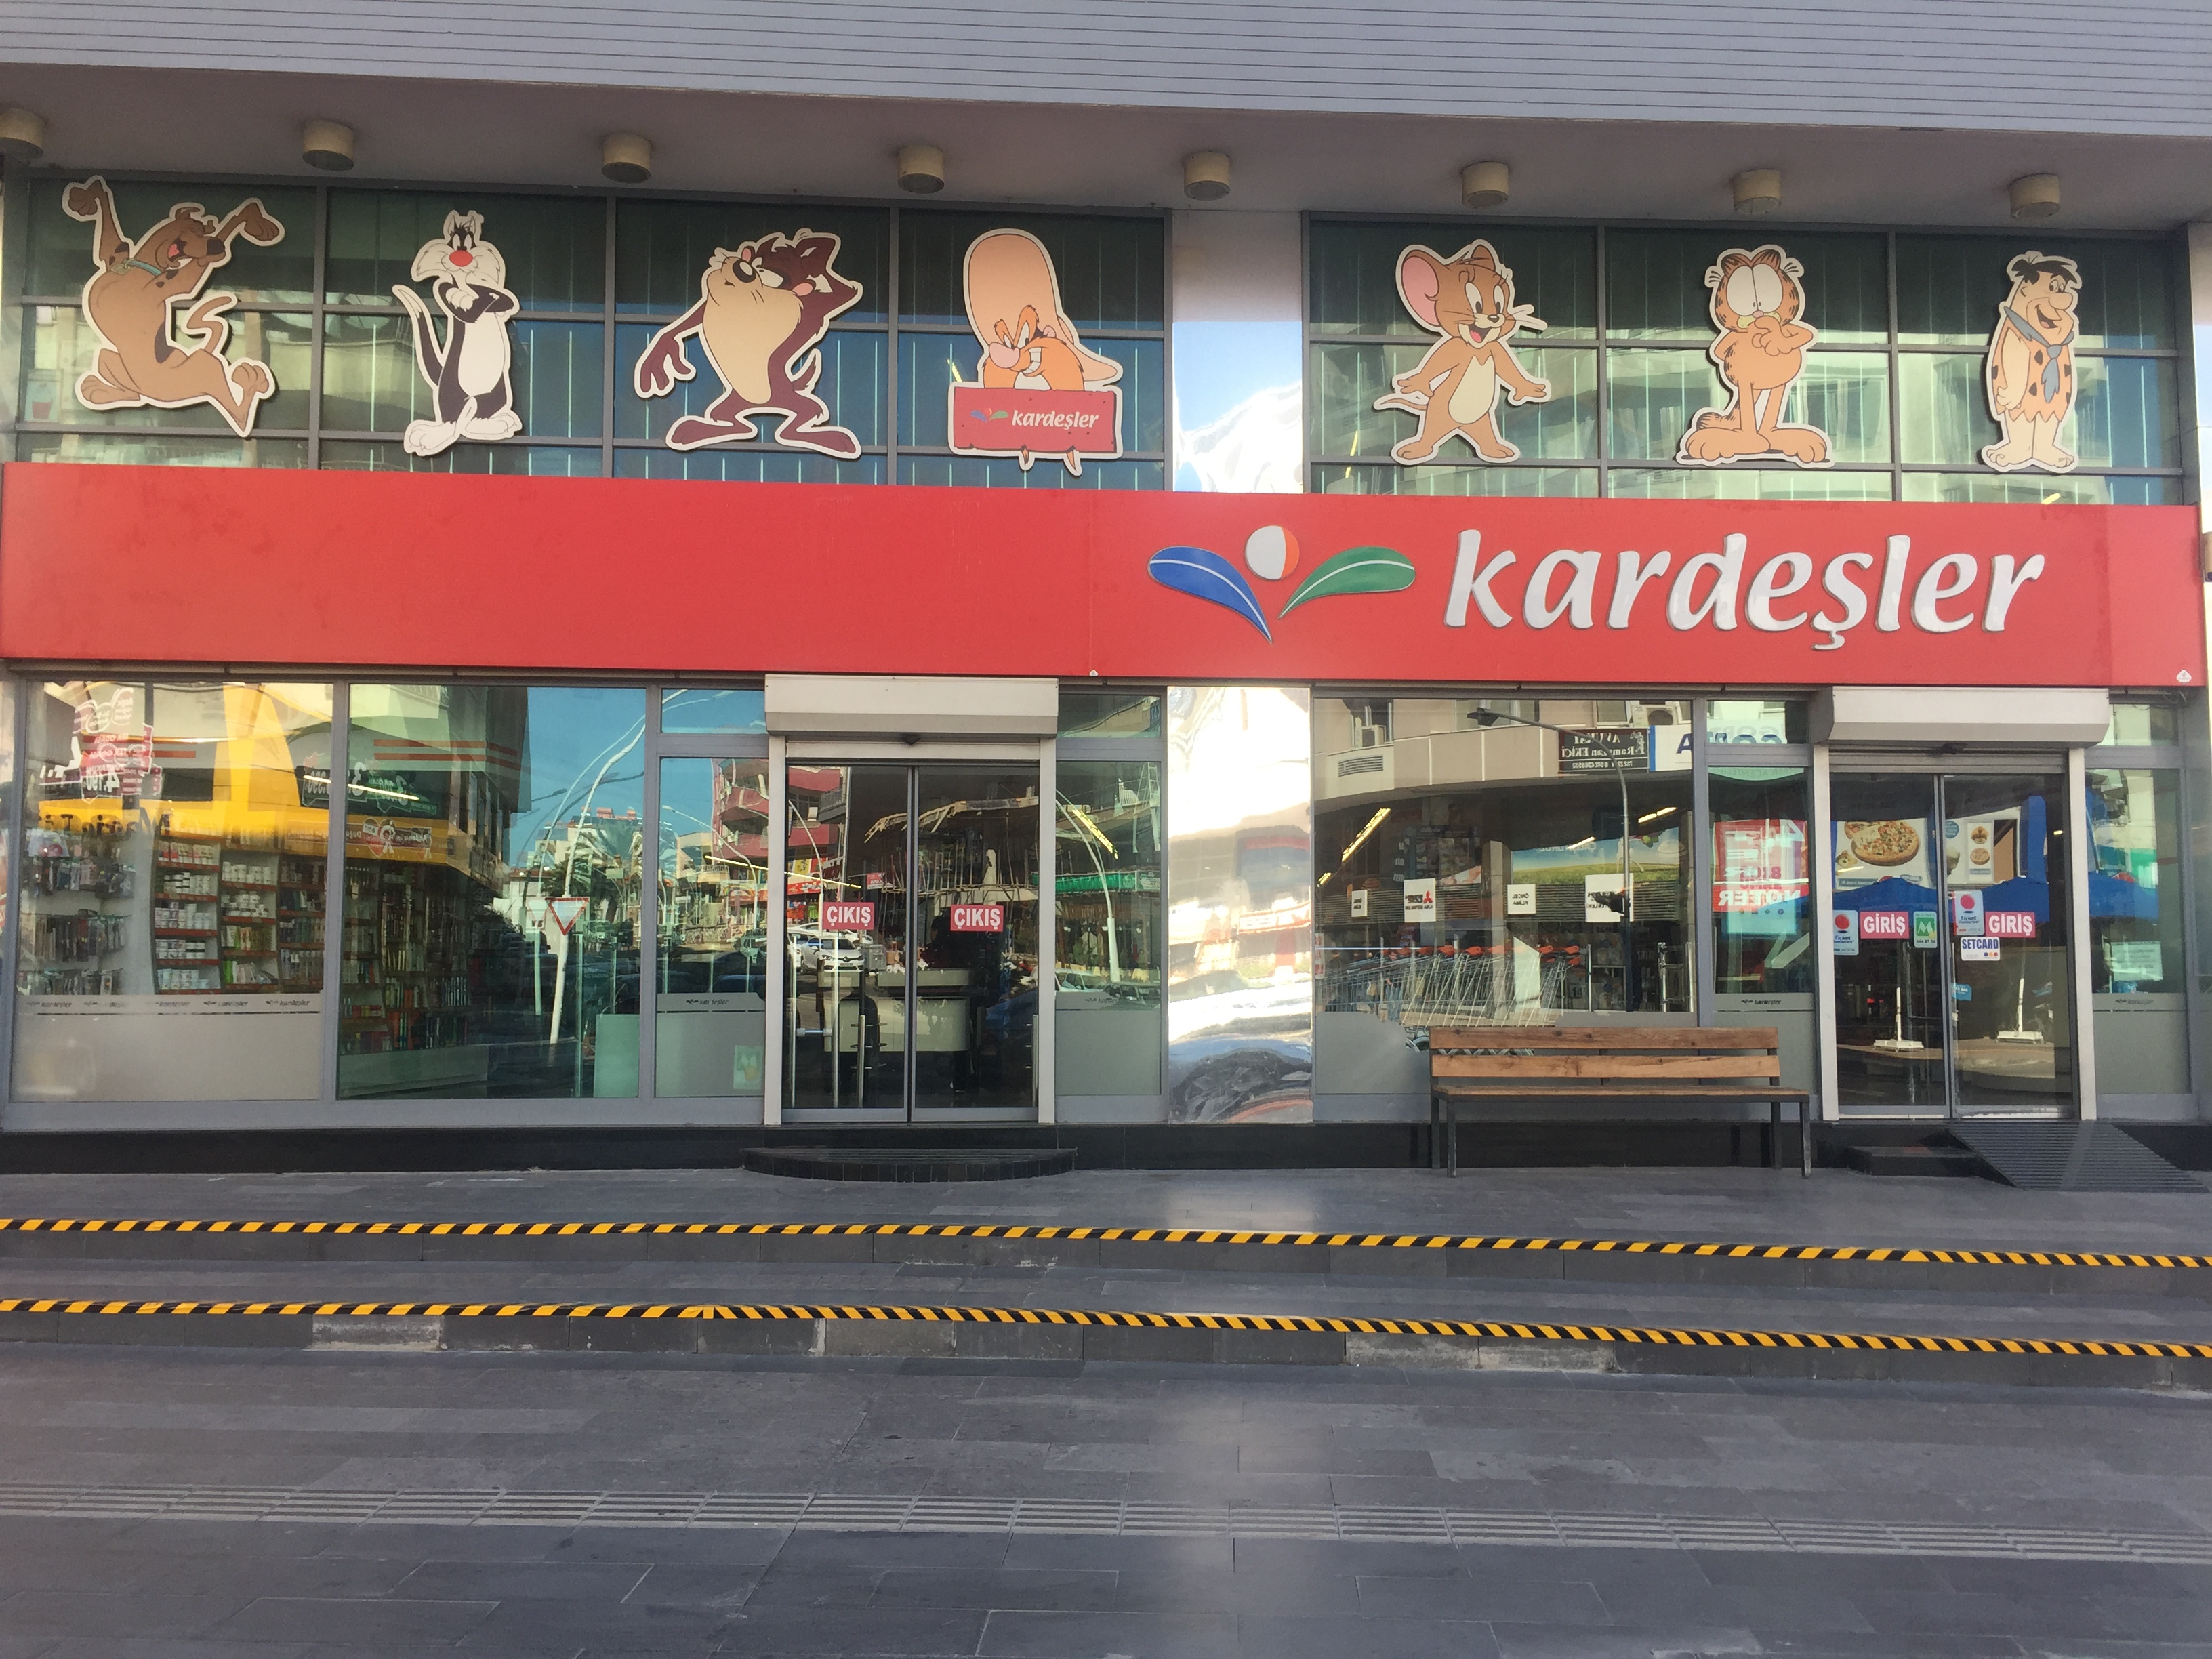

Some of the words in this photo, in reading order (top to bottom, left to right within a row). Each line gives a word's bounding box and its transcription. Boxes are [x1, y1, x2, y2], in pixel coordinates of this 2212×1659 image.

[1012, 409, 1099, 430] kardeşler
[1443, 529, 2045, 652] kardeşler
[827, 905, 872, 926] ÇIKIŞ
[954, 907, 1001, 930] ÇIKIŞ
[1863, 913, 1906, 936] GİRİŞ
[1988, 913, 2033, 936] GİRİŞ
[1961, 939, 1999, 950] SETCARD
